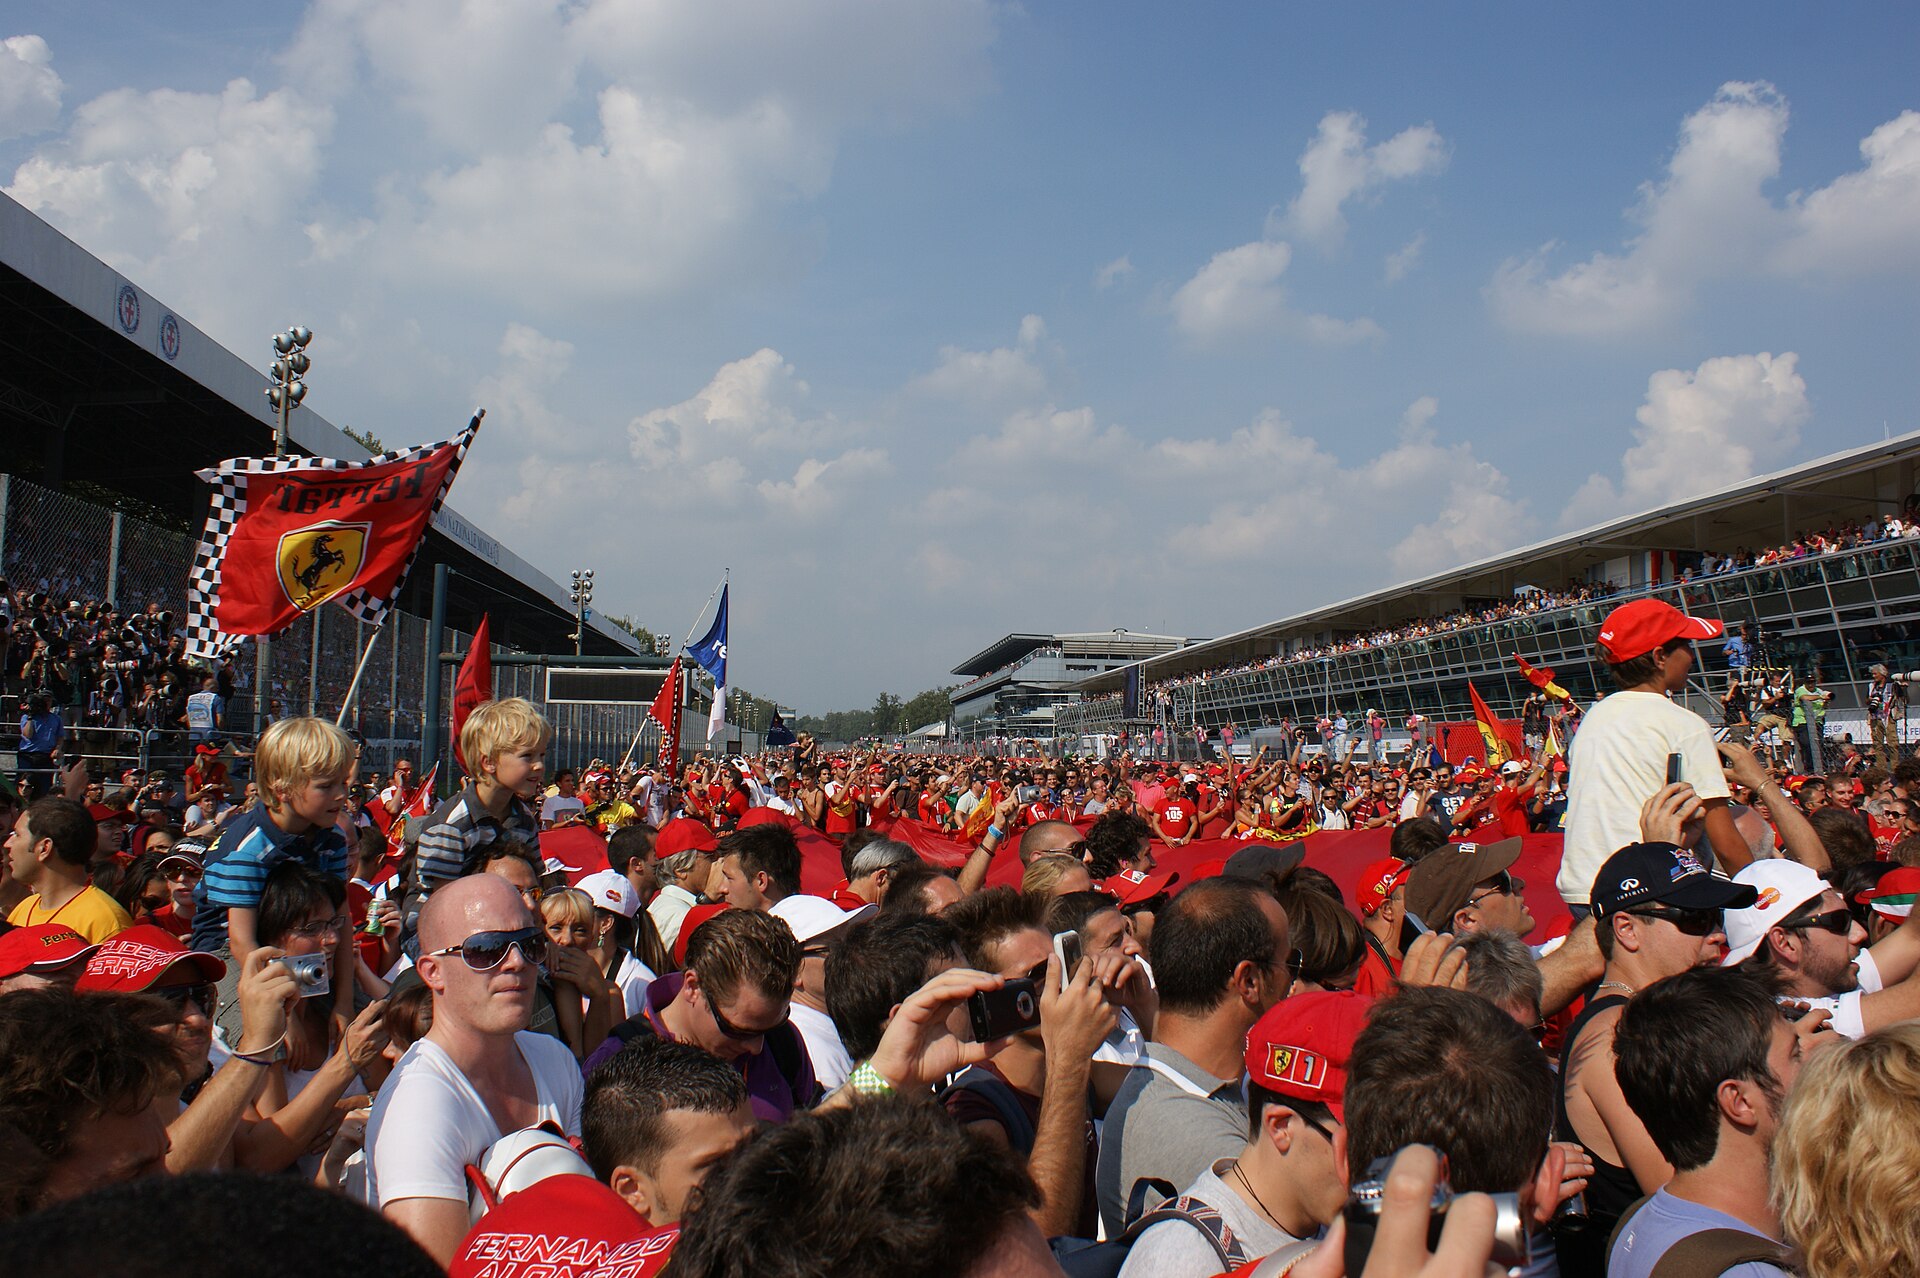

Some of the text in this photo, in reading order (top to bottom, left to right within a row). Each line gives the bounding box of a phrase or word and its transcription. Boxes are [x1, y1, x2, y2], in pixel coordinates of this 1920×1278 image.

[1165, 810, 1183, 820] 105
[1616, 887, 1648, 901] INFINITI
[40, 931, 79, 947] Ferr
[1304, 1055, 1315, 1082] 1
[465, 1229, 680, 1266] FERNANDO
